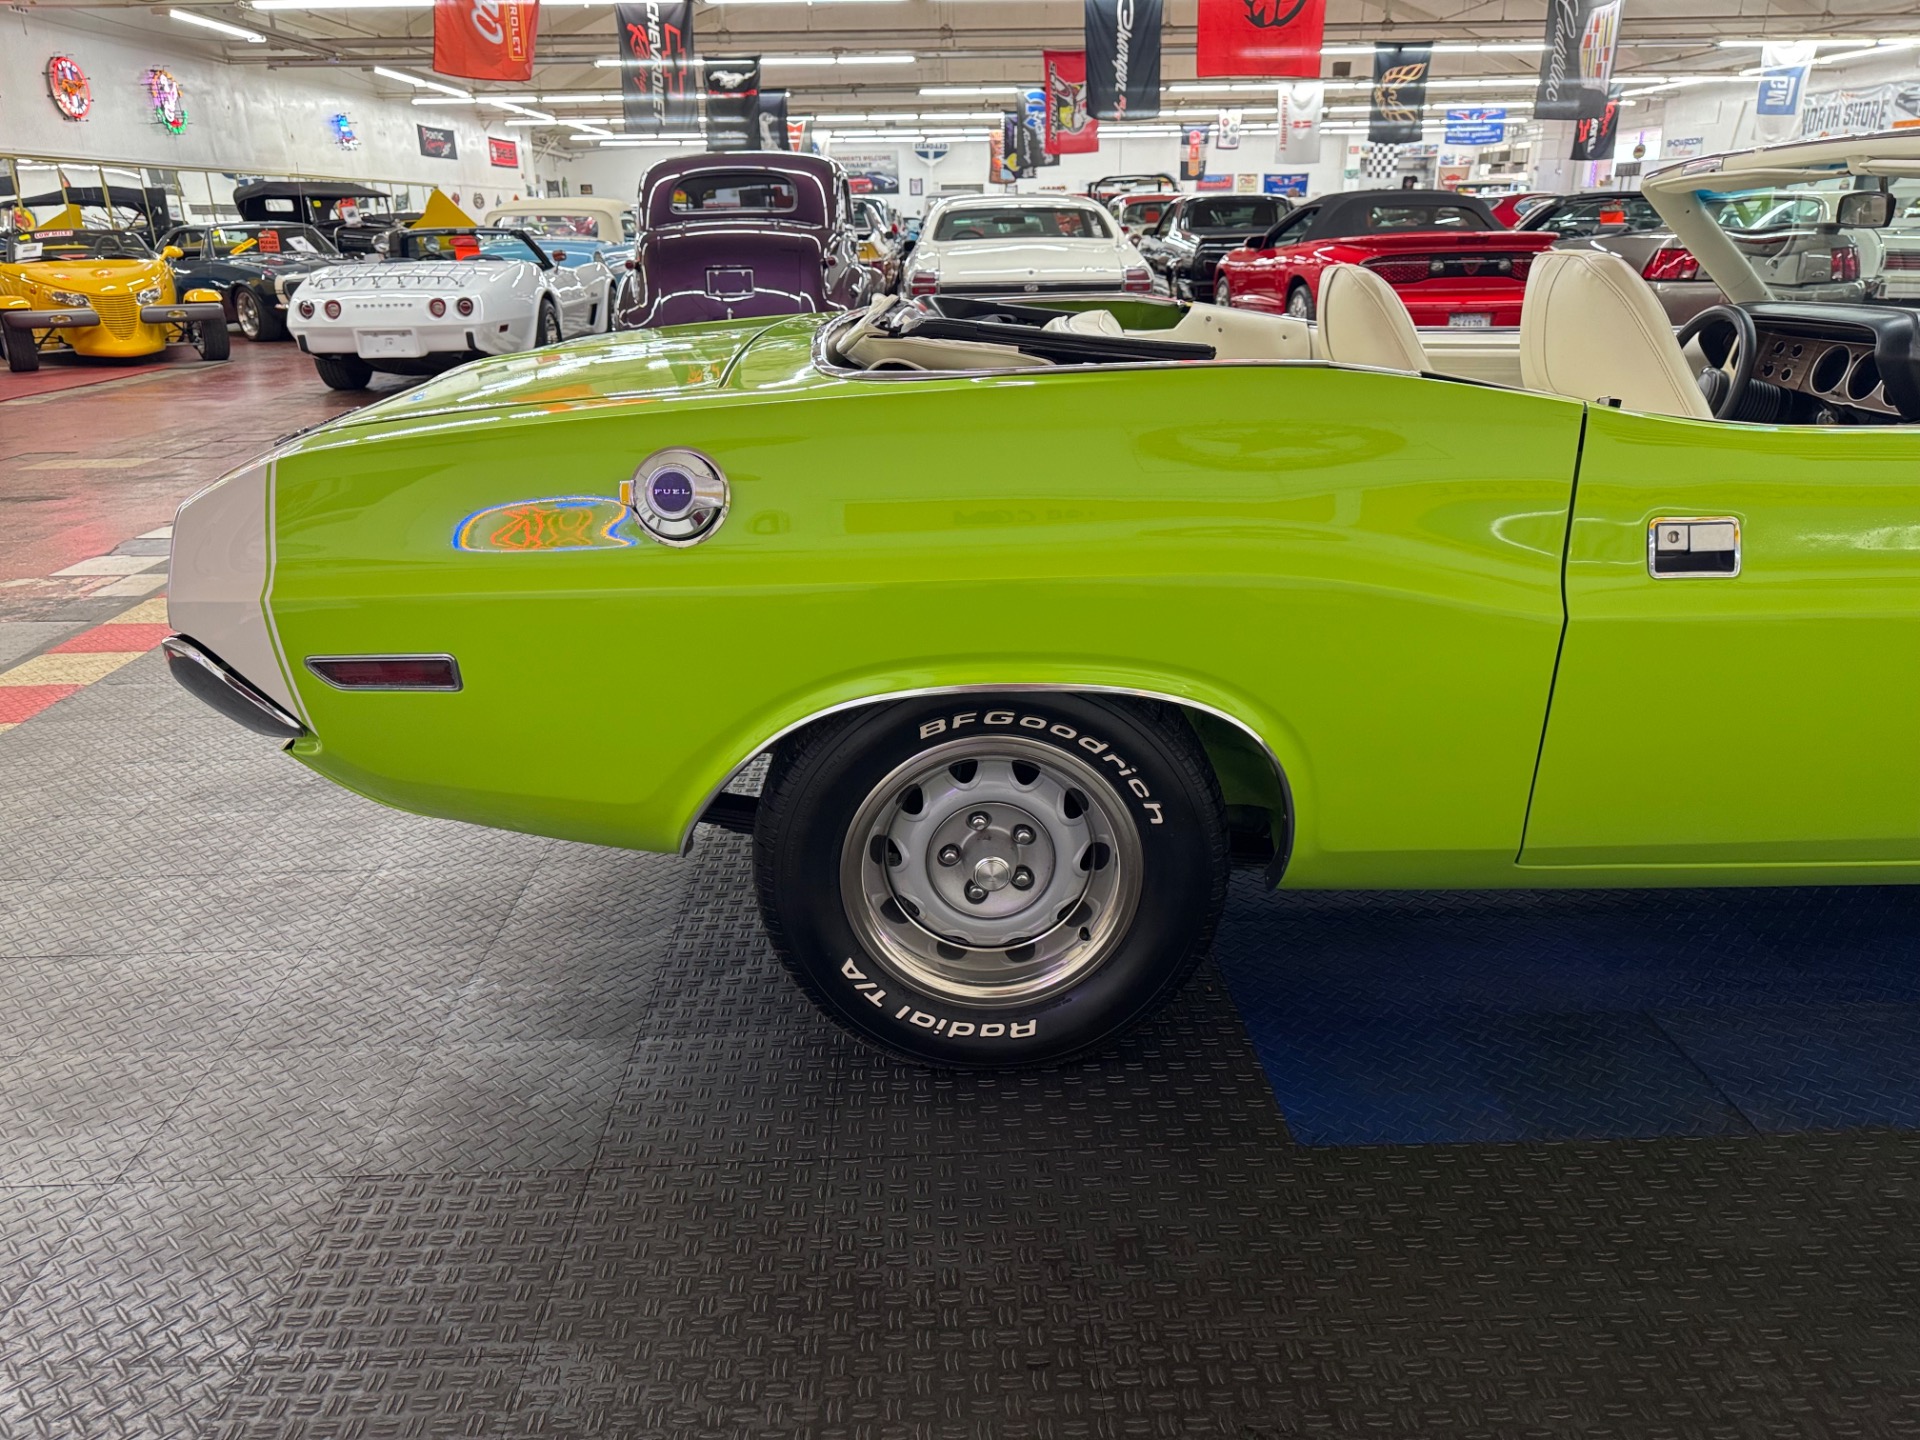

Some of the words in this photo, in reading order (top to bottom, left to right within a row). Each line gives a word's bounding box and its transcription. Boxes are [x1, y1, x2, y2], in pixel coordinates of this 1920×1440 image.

[509, 0, 522, 54] ROLET
[626, 23, 651, 94] Raing
[1111, 0, 1134, 92] Charger
[1545, 0, 1581, 102] Cadillac
[646, 1, 667, 126] CHEVROLET
[1801, 103, 1842, 137] NORTH
[1843, 99, 1890, 130] SHORE
[919, 711, 1164, 825] BFGoodrich
[841, 957, 887, 1008] T/A
[895, 1005, 1037, 1038] Radial
